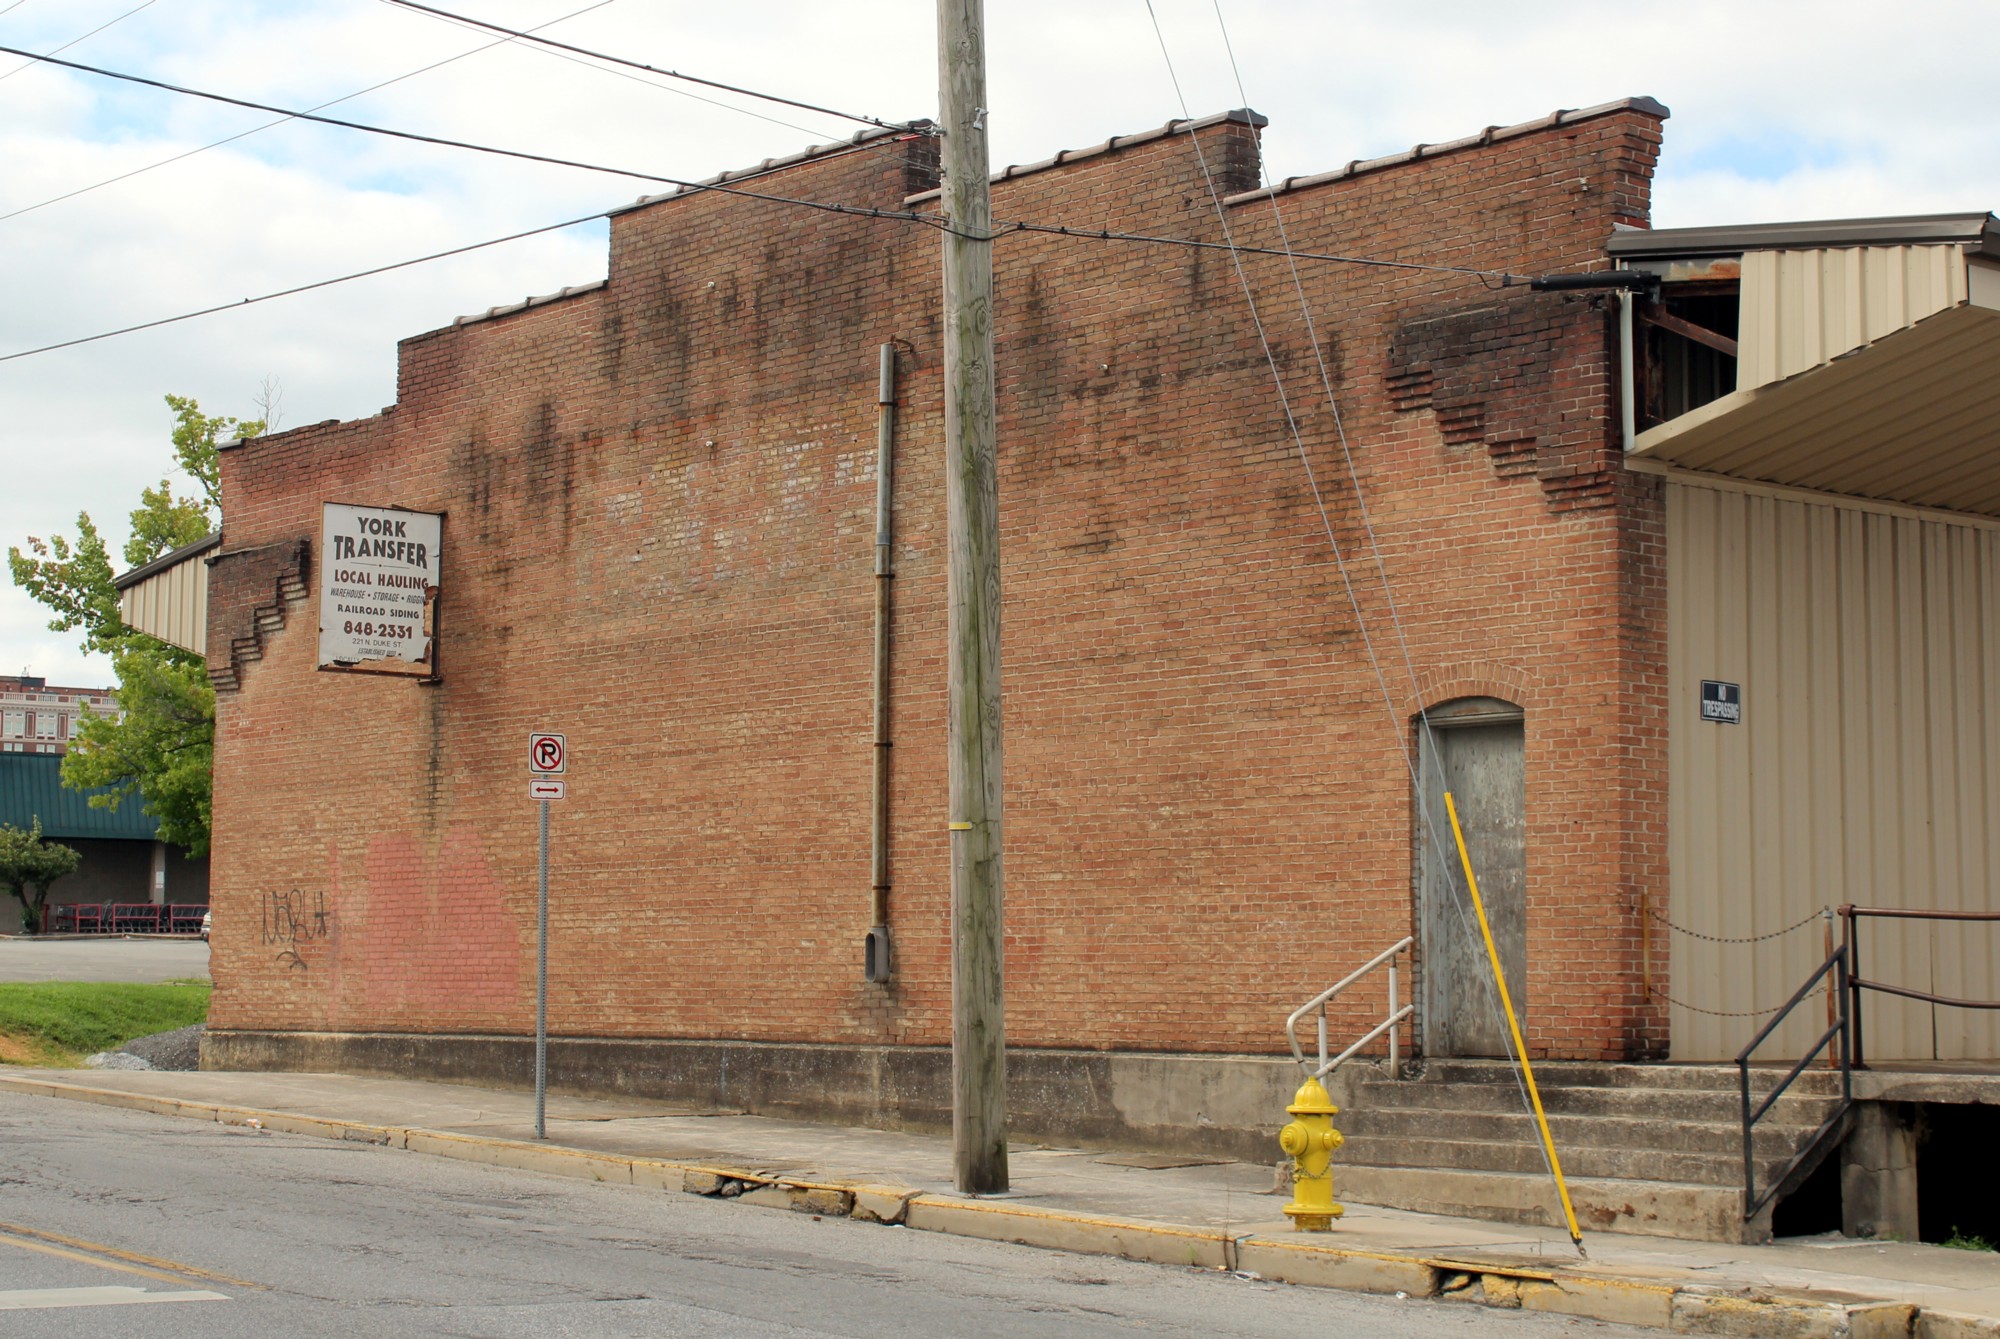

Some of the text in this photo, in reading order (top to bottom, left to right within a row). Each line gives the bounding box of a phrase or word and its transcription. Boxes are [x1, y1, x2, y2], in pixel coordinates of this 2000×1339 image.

[357, 516, 406, 537] YORK
[334, 535, 427, 569] TRANSFER
[334, 569, 428, 589] LOCAL HAULING
[330, 588, 425, 604] WAREHOUSE STORAGE RIGGIN
[337, 603, 386, 616] RAILROAD
[390, 608, 420, 619] SIDING
[344, 620, 412, 639] 848-2331
[352, 637, 364, 645] 221
[1718, 684, 1726, 701] NO
[1703, 699, 1739, 719] TRESPASSING
